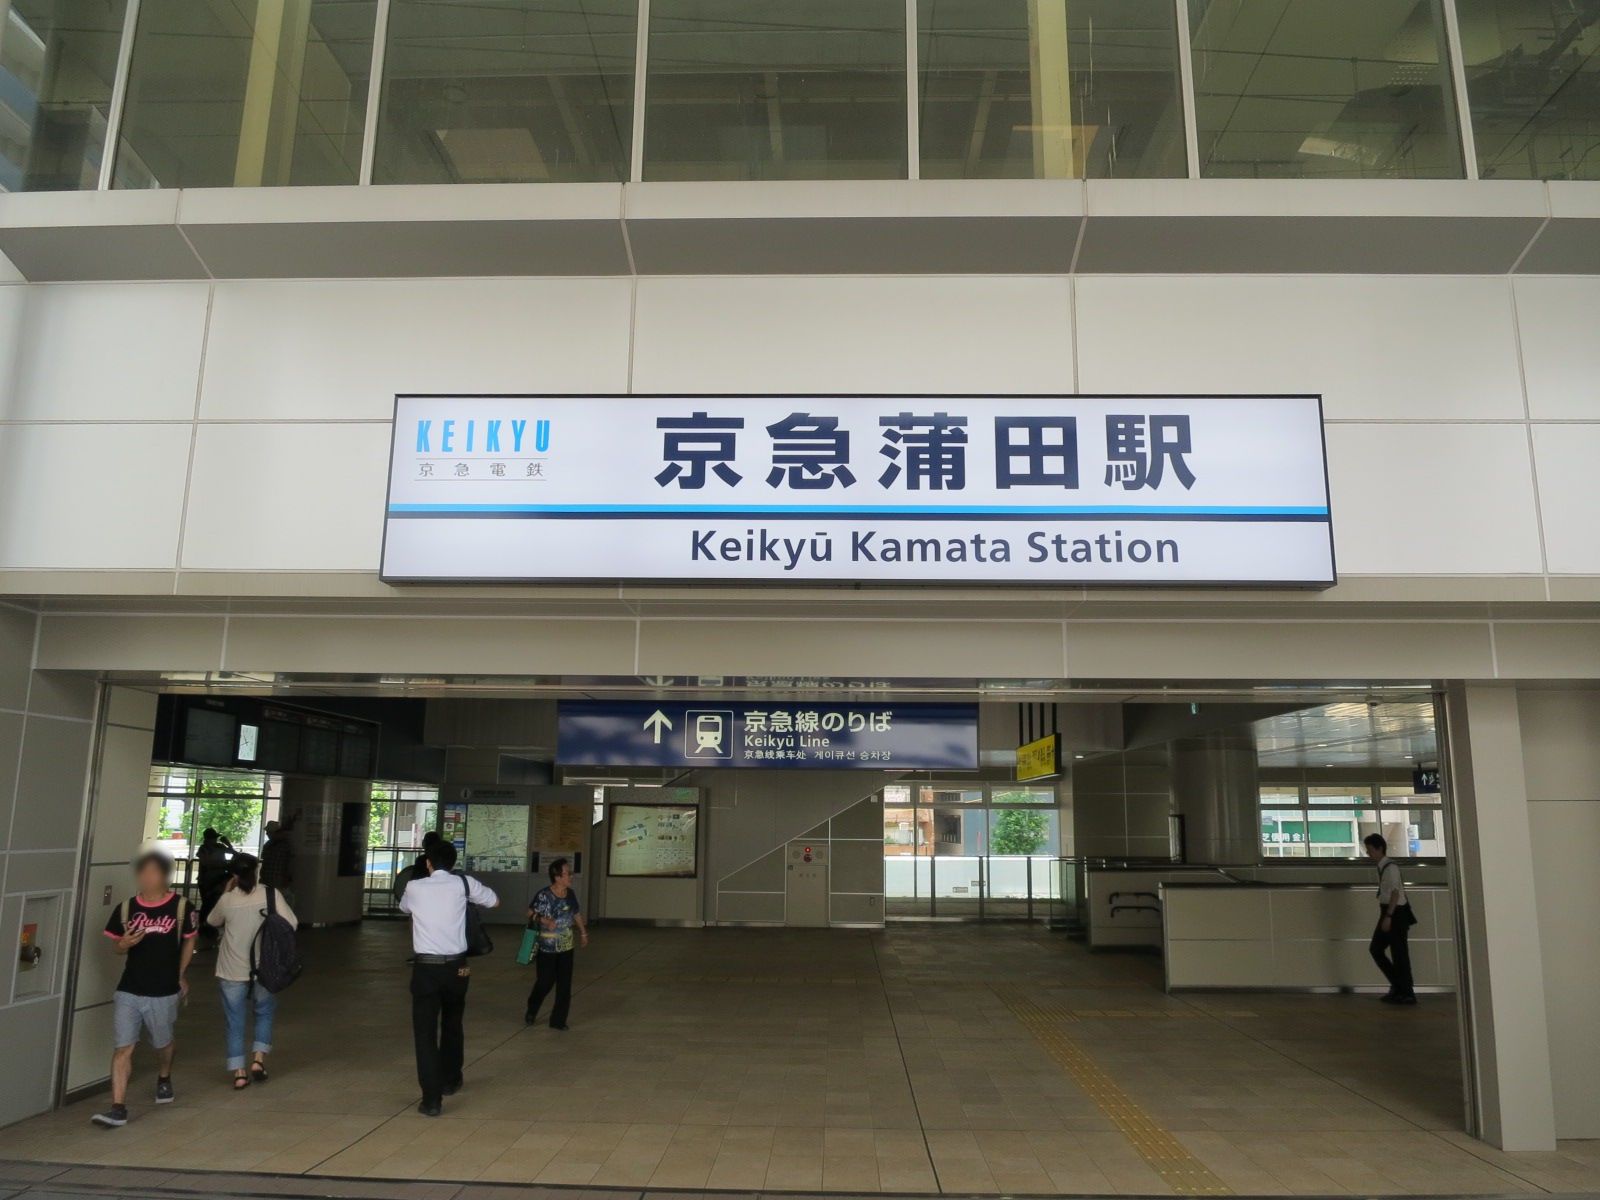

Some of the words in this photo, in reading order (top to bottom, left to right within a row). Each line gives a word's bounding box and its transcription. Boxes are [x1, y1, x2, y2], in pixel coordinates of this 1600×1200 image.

[416, 419, 551, 453] KEIKYU
[654, 411, 1196, 491] 京急蒲田駅
[418, 462, 544, 477] 京急電鉄
[692, 529, 831, 571] Keikyū
[852, 531, 1010, 563] Kamata
[1028, 530, 1178, 563] Station
[743, 710, 893, 733] 京急線のりば
[744, 734, 794, 750] Keikyū
[800, 734, 830, 748] Line
[814, 750, 856, 760] 게이큐선
[859, 750, 891, 761] 승차장
[128, 912, 176, 933] Rusty
